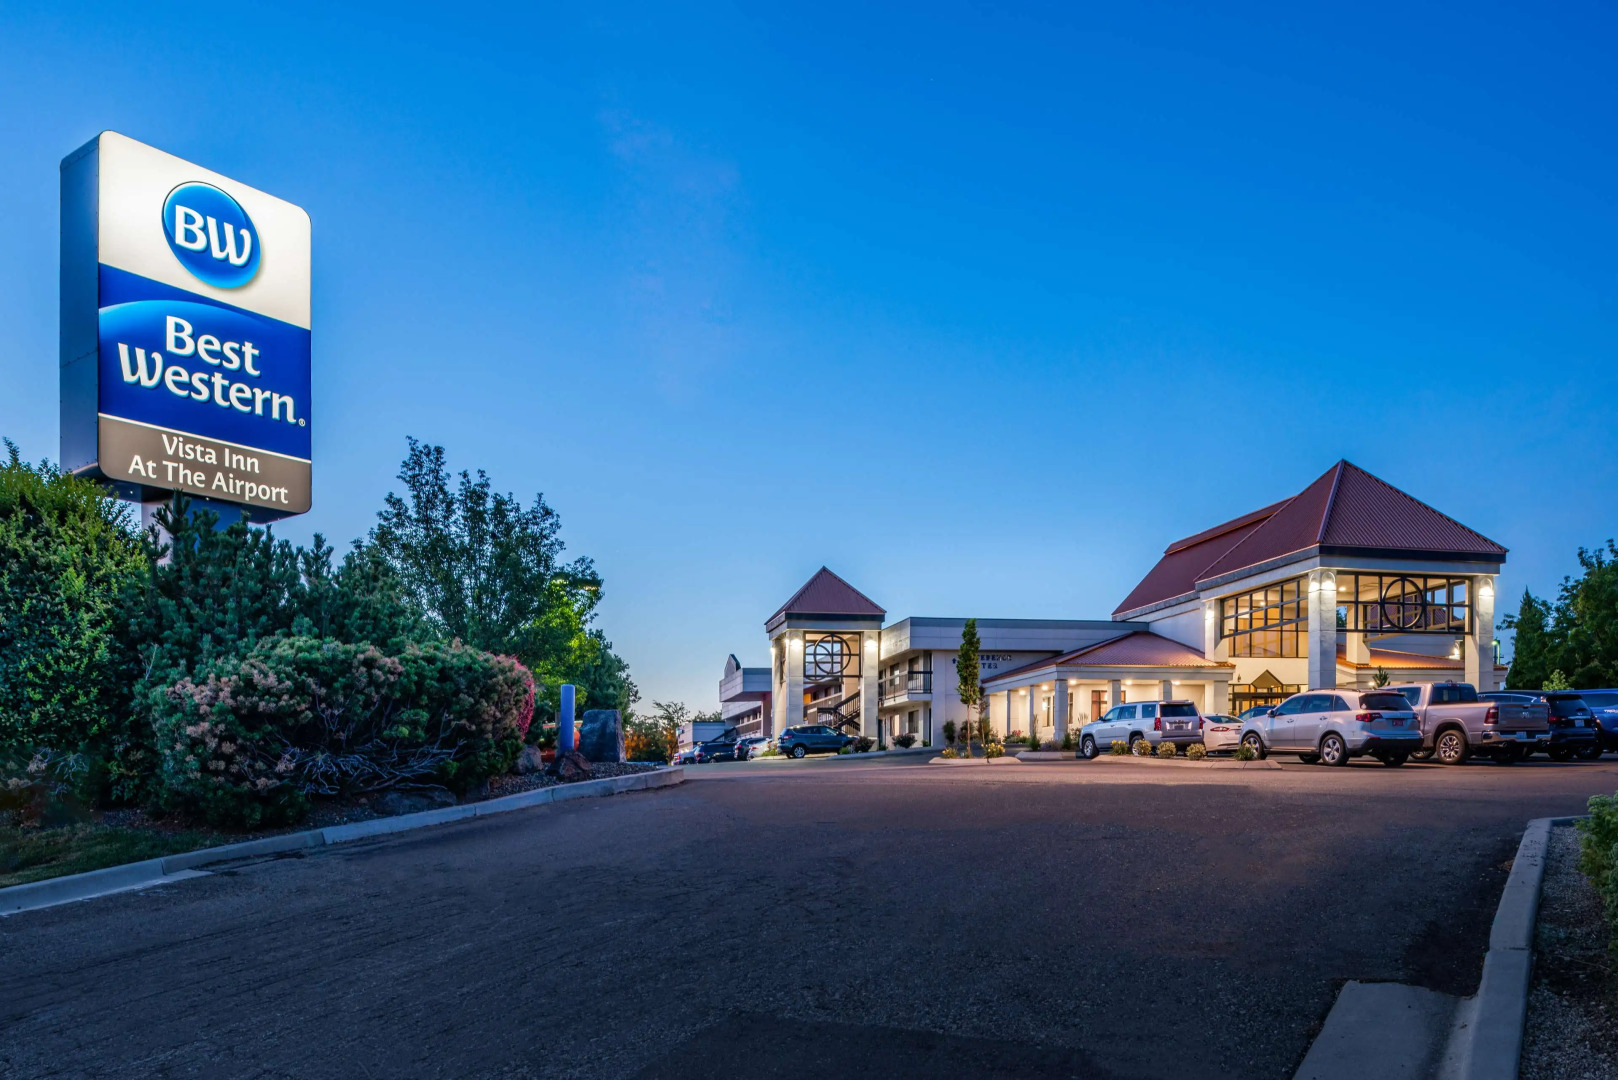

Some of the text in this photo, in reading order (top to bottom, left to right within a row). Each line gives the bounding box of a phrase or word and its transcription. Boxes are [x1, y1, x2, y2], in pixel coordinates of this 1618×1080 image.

[175, 204, 251, 266] BW
[166, 315, 261, 377] Best
[128, 455, 288, 504] At The Airport
[162, 434, 259, 473] Vista Inn
